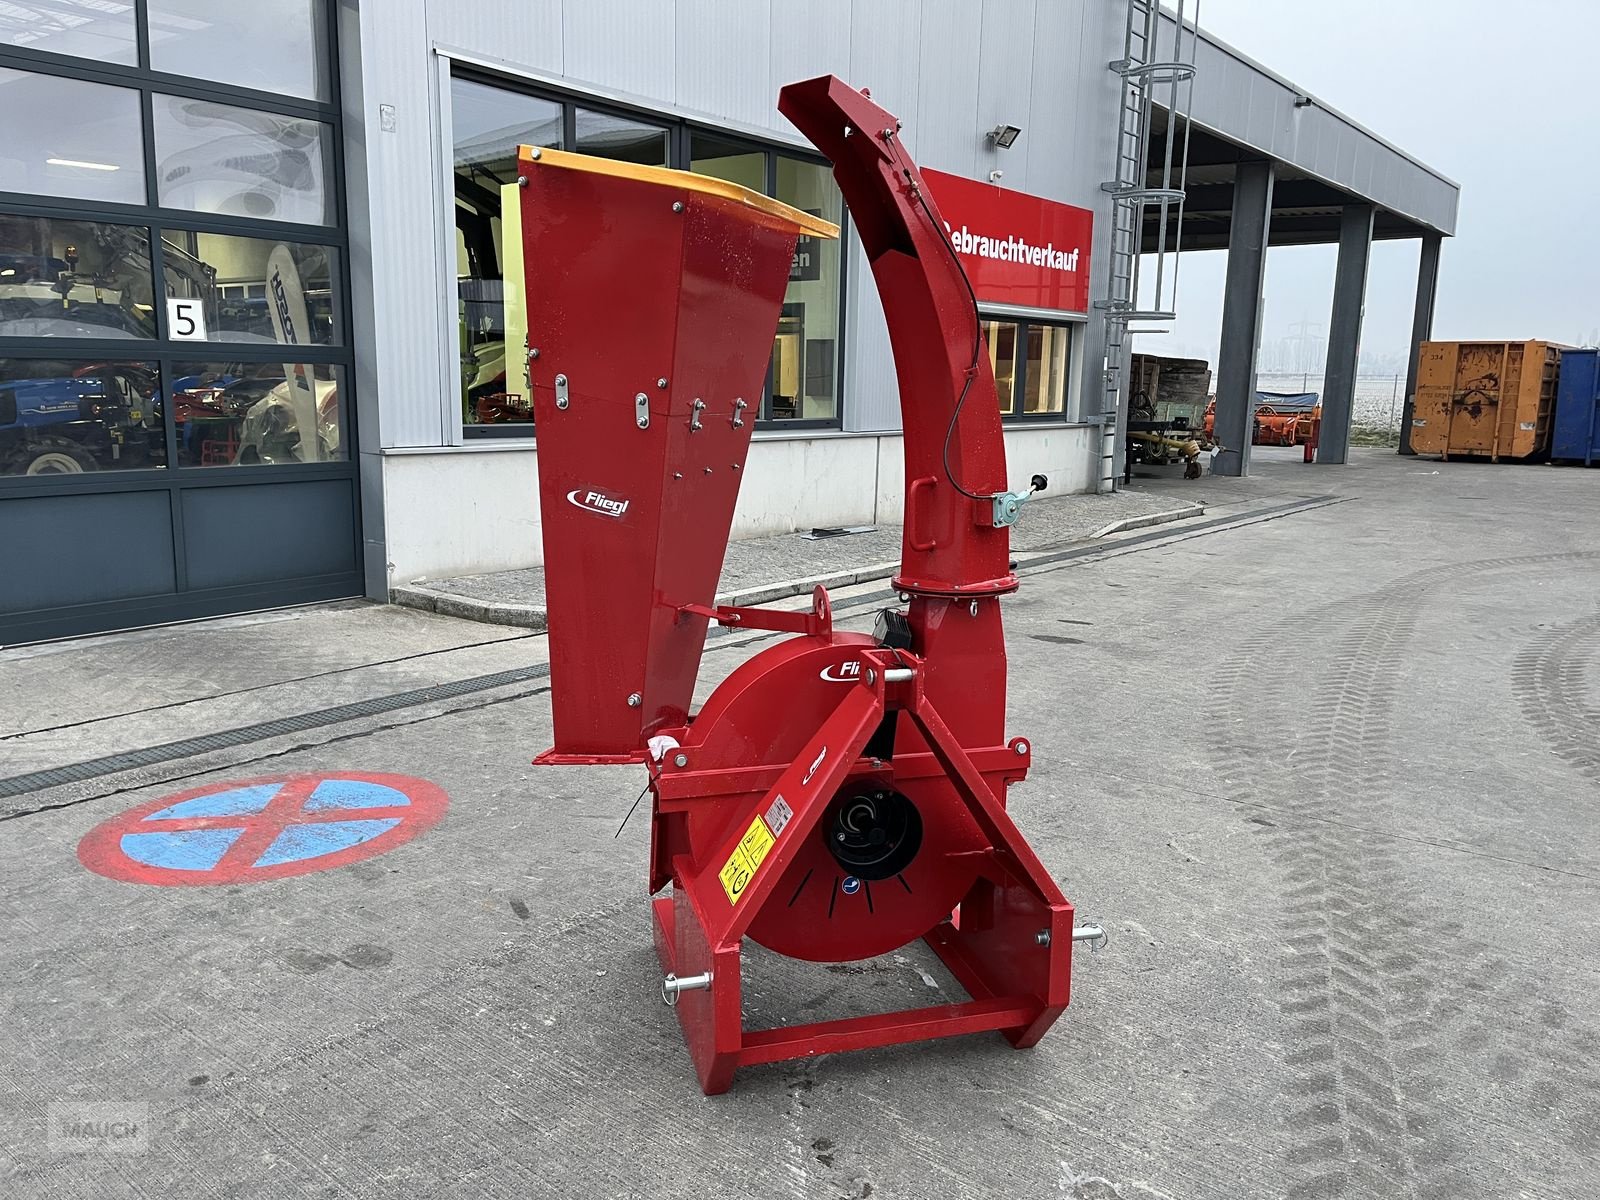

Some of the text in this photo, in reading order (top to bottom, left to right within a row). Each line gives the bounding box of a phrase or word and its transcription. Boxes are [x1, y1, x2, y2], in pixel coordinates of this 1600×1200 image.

[176, 304, 196, 336] 5
[584, 491, 630, 515] Fliegl
[839, 661, 861, 676] Fli
